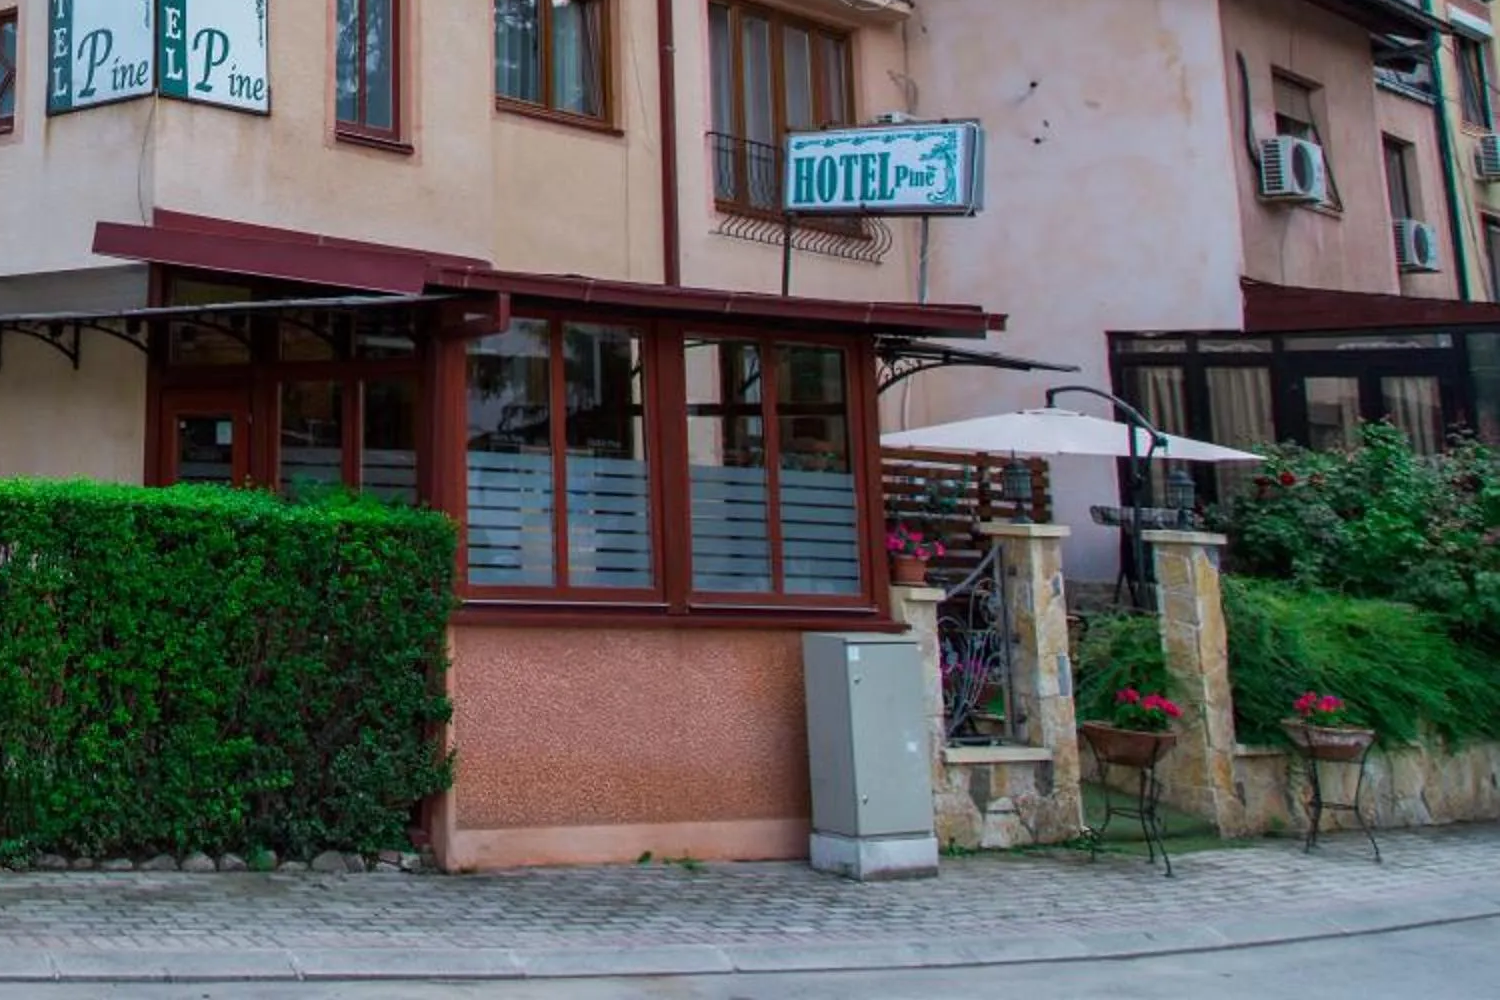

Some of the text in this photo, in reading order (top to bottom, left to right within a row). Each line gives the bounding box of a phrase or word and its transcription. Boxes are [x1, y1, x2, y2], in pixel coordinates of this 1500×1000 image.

[77, 28, 150, 98] Pine
[192, 28, 265, 100] Pine
[794, 152, 895, 203] HOTEL
